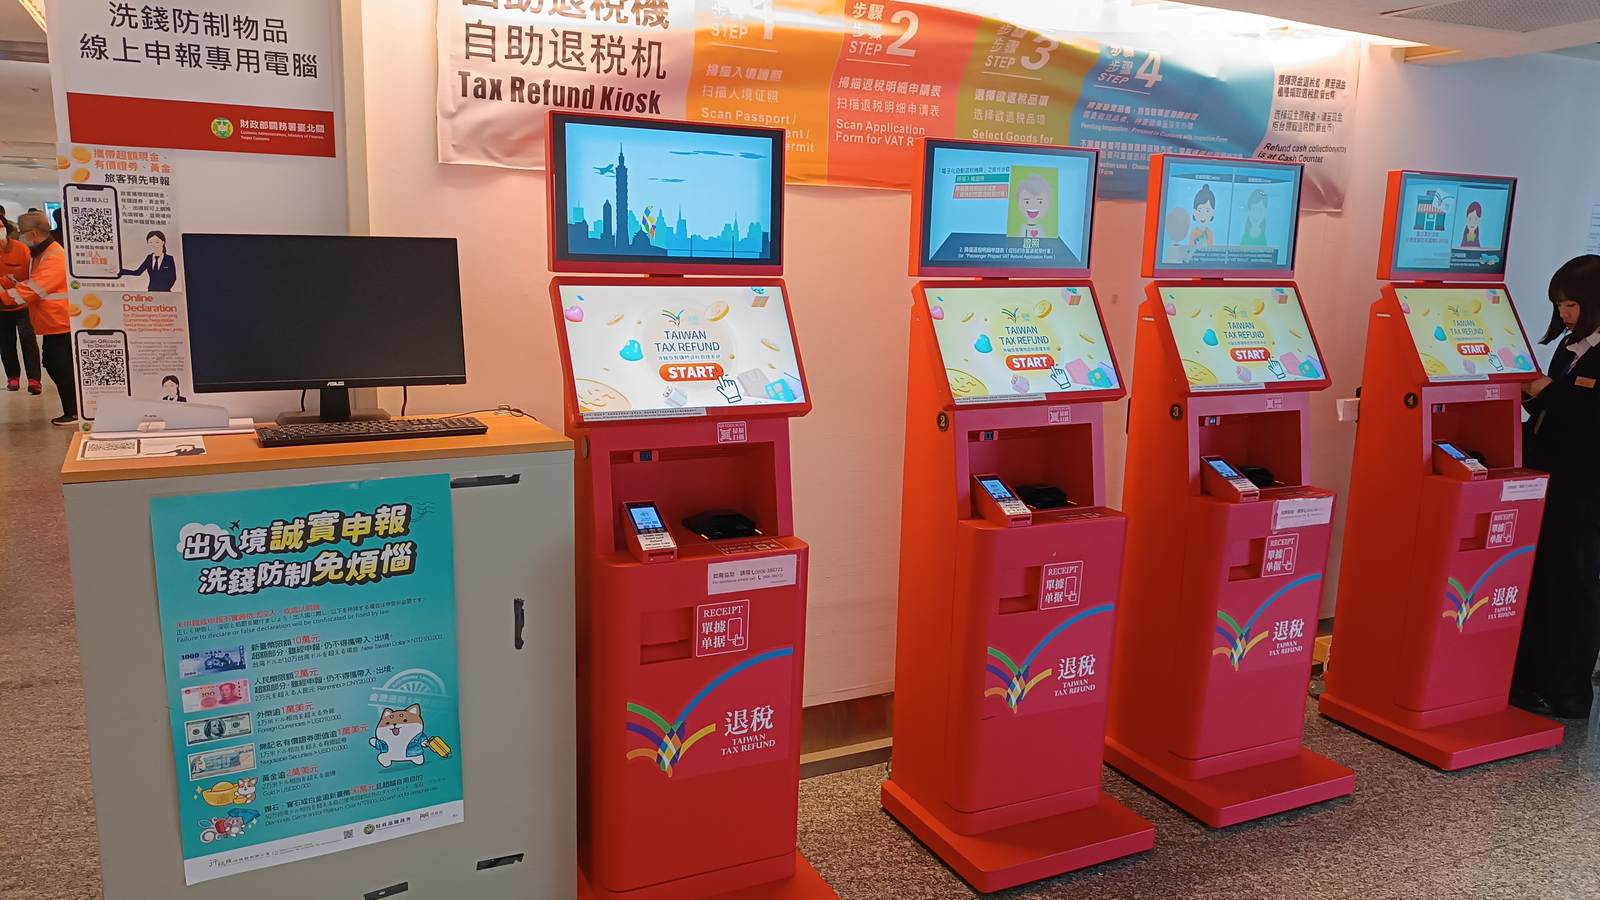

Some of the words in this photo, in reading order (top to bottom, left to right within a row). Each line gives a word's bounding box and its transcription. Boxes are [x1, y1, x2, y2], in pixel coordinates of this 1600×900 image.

[109, 1, 288, 44] 洗錢防制物品
[711, 22, 749, 40] STEP
[849, 40, 882, 56] STEP
[886, 10, 919, 57] 2
[80, 33, 318, 79] 線上申報專用電腦
[464, 20, 666, 80] 自助退税机
[985, 55, 1015, 69] STEP
[1020, 35, 1059, 70] 3
[1097, 72, 1129, 84] STEP
[1135, 51, 1162, 88] 4
[458, 71, 503, 101] Tax
[510, 76, 595, 110] Refund
[599, 86, 661, 115] Kiosk
[701, 107, 732, 120] Scan
[735, 110, 790, 126] Passport
[836, 118, 863, 131] Scan
[865, 121, 926, 136] Application
[836, 131, 863, 143] Form
[866, 133, 881, 145] for
[884, 135, 904, 146] VAT
[972, 129, 1004, 141] Select
[1006, 131, 1038, 143] Goods
[1039, 134, 1054, 144] for
[1264, 143, 1291, 153] Refund
[1278, 153, 1297, 162] Cash
[105, 173, 170, 186] 旅客預先申報
[122, 294, 153, 302] Online
[123, 304, 177, 312] Declaration
[1005, 326, 1038, 335] TAIWAN
[1227, 322, 1255, 330] TAIWAN
[664, 331, 706, 340] TAIWAN
[1000, 337, 1015, 345] TAX
[1018, 336, 1049, 345] REFUND
[1223, 331, 1237, 339] TAX
[1238, 331, 1265, 339] REFUND
[655, 343, 676, 352] TAX
[678, 342, 720, 352] REFUND
[1460, 345, 1485, 354] START
[1236, 350, 1266, 360] START
[1012, 357, 1048, 368] START
[668, 366, 715, 378] START
[1407, 395, 1414, 406] 4
[1172, 407, 1179, 416] 3
[939, 416, 946, 427] 2
[183, 504, 408, 560] 出入境誠實申報
[1269, 537, 1295, 546] RECEIPT
[199, 542, 413, 594] 洗錢防制免煩惱
[1048, 565, 1078, 576] RECEIPT
[1046, 578, 1065, 590] 單據
[1045, 591, 1063, 604] 单据
[1492, 586, 1519, 606] 退稅
[703, 605, 743, 618] RECEIPT
[702, 620, 726, 635] 單據
[1272, 618, 1305, 642] 退稅
[702, 635, 726, 650] 单据
[182, 652, 200, 660] 1000
[1057, 653, 1096, 681] 退稅
[1063, 678, 1089, 689] TAIWAN
[1054, 688, 1068, 697] TAX
[1069, 684, 1096, 695] REFUND
[724, 705, 774, 736] 退稅
[731, 733, 766, 746] TAIWAN
[721, 747, 739, 756] TAX
[741, 739, 776, 752] REFUND
